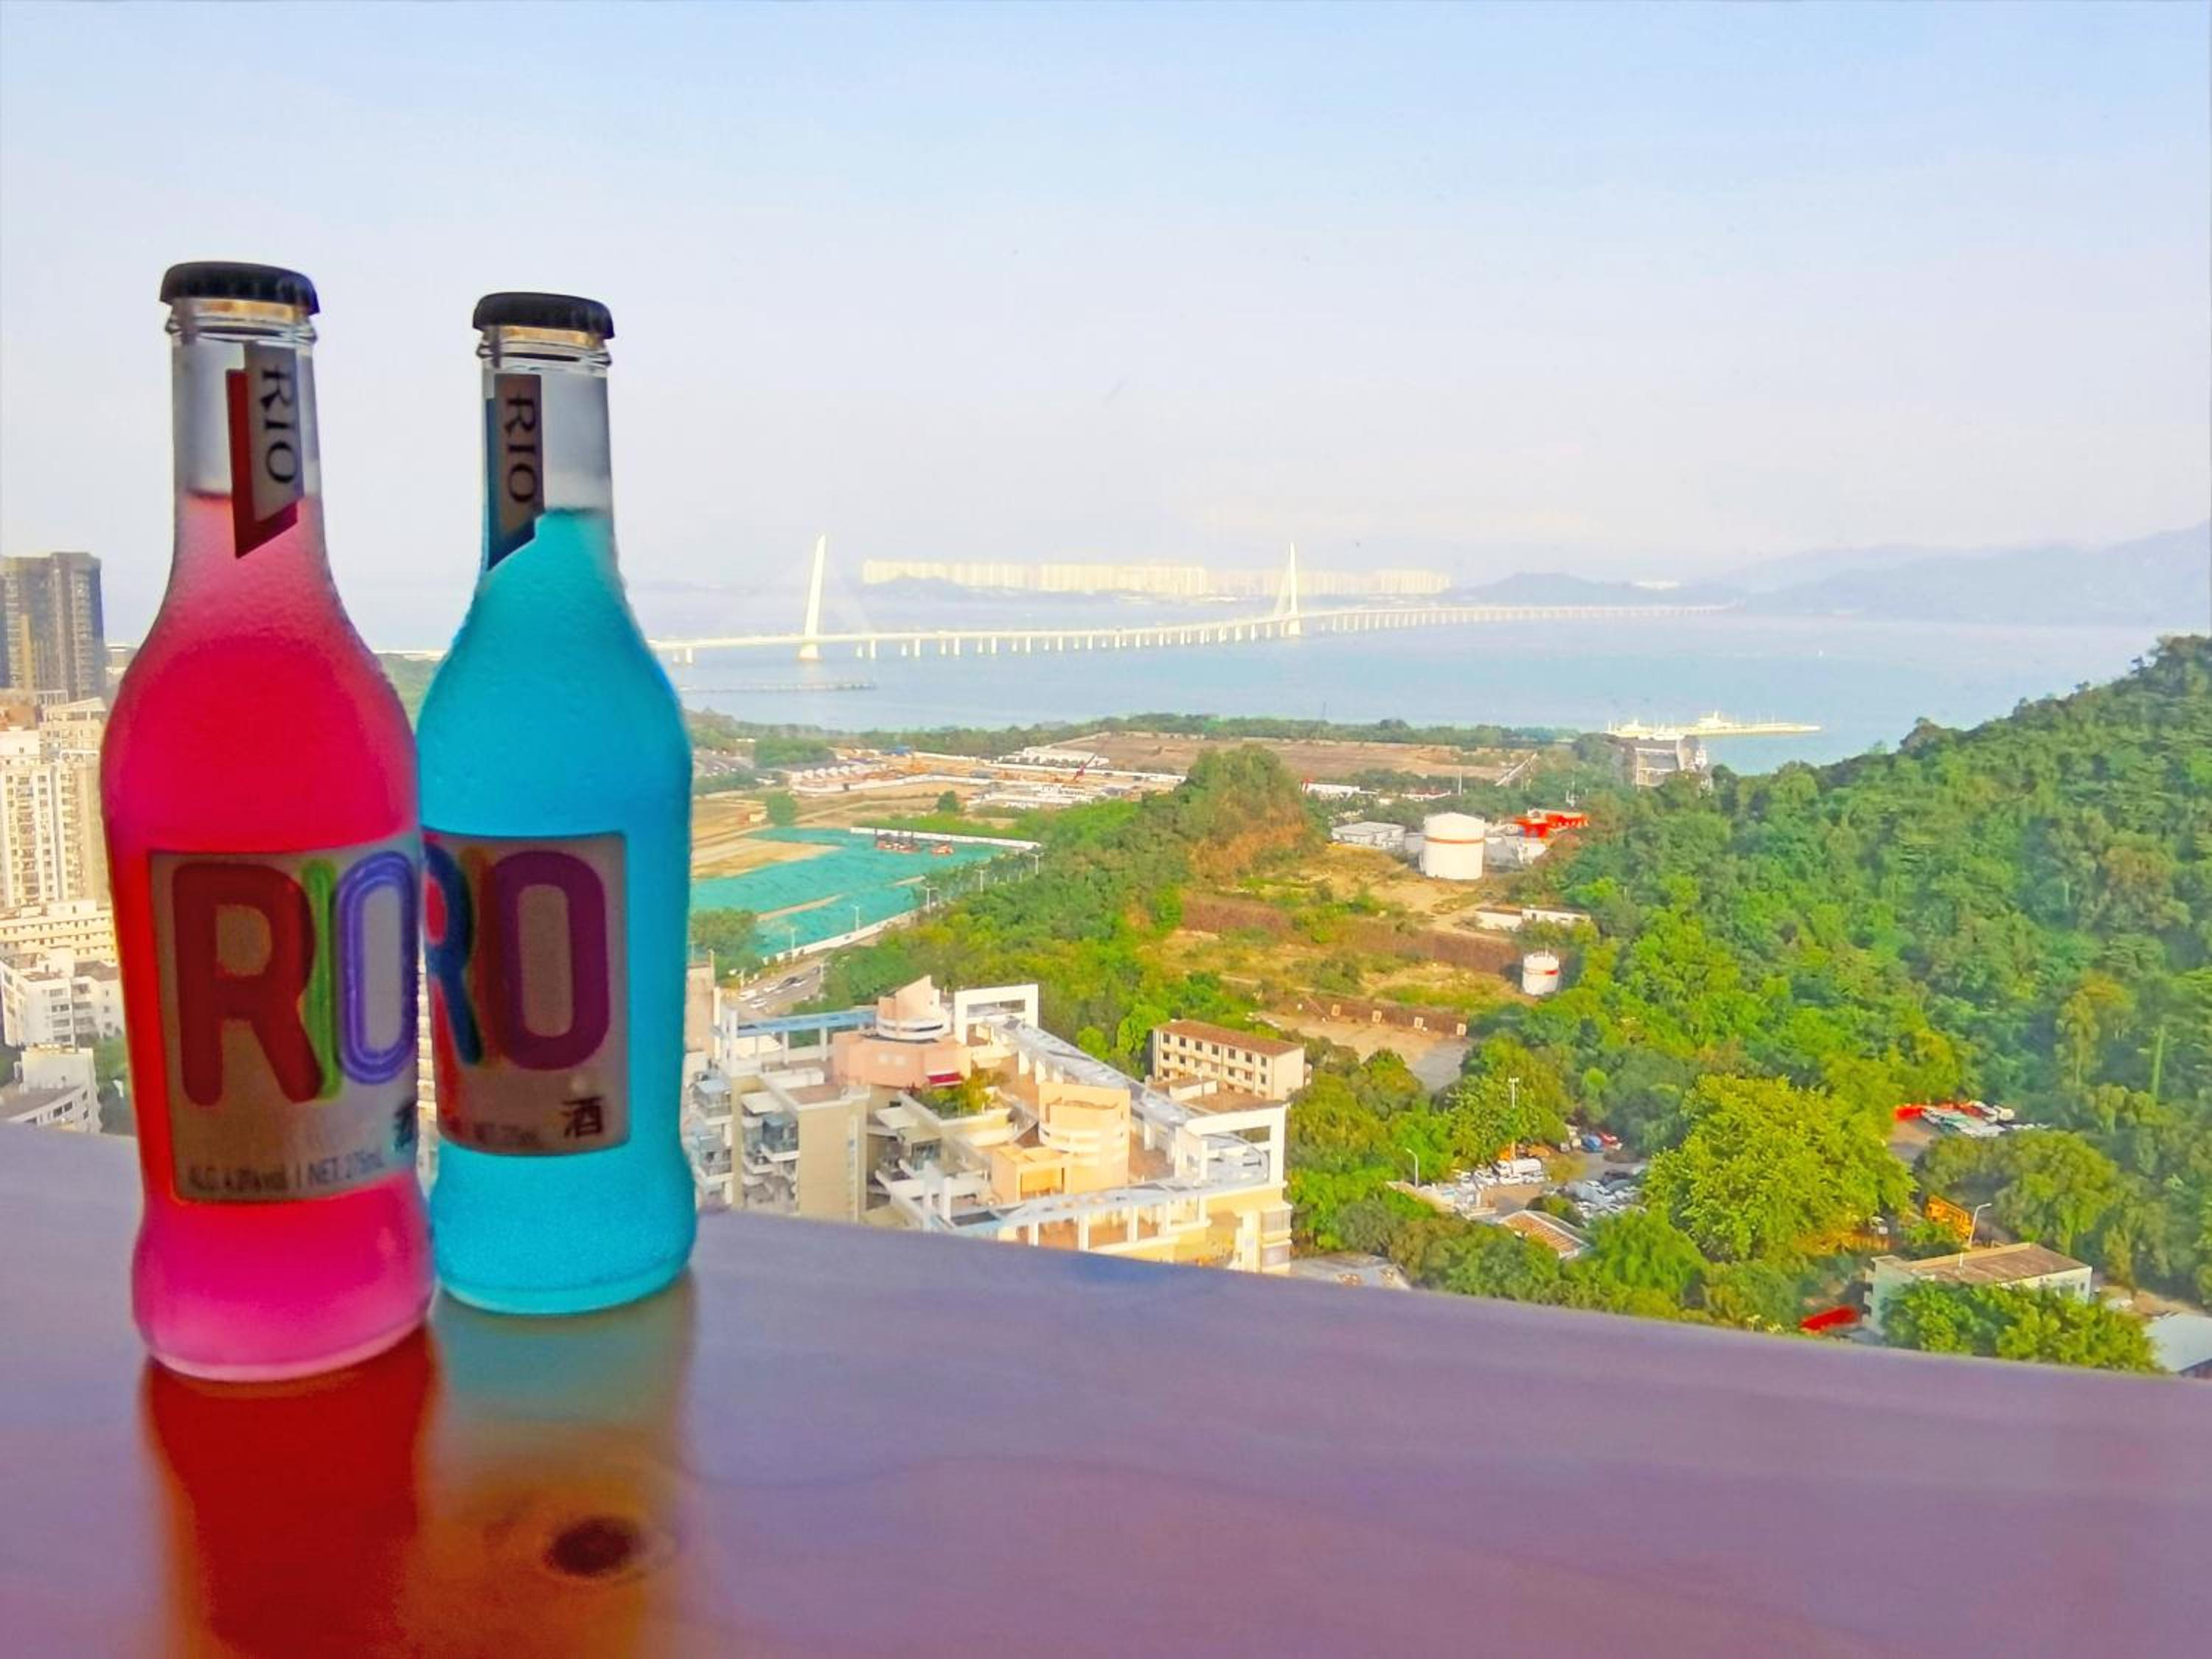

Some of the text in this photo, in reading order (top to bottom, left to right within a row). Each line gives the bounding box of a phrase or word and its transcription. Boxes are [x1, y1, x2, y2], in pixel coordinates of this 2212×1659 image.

[260, 366, 298, 484] RIO
[504, 394, 537, 503] RIO
[172, 851, 419, 1107] RIO
[559, 1094, 605, 1138] 酒
